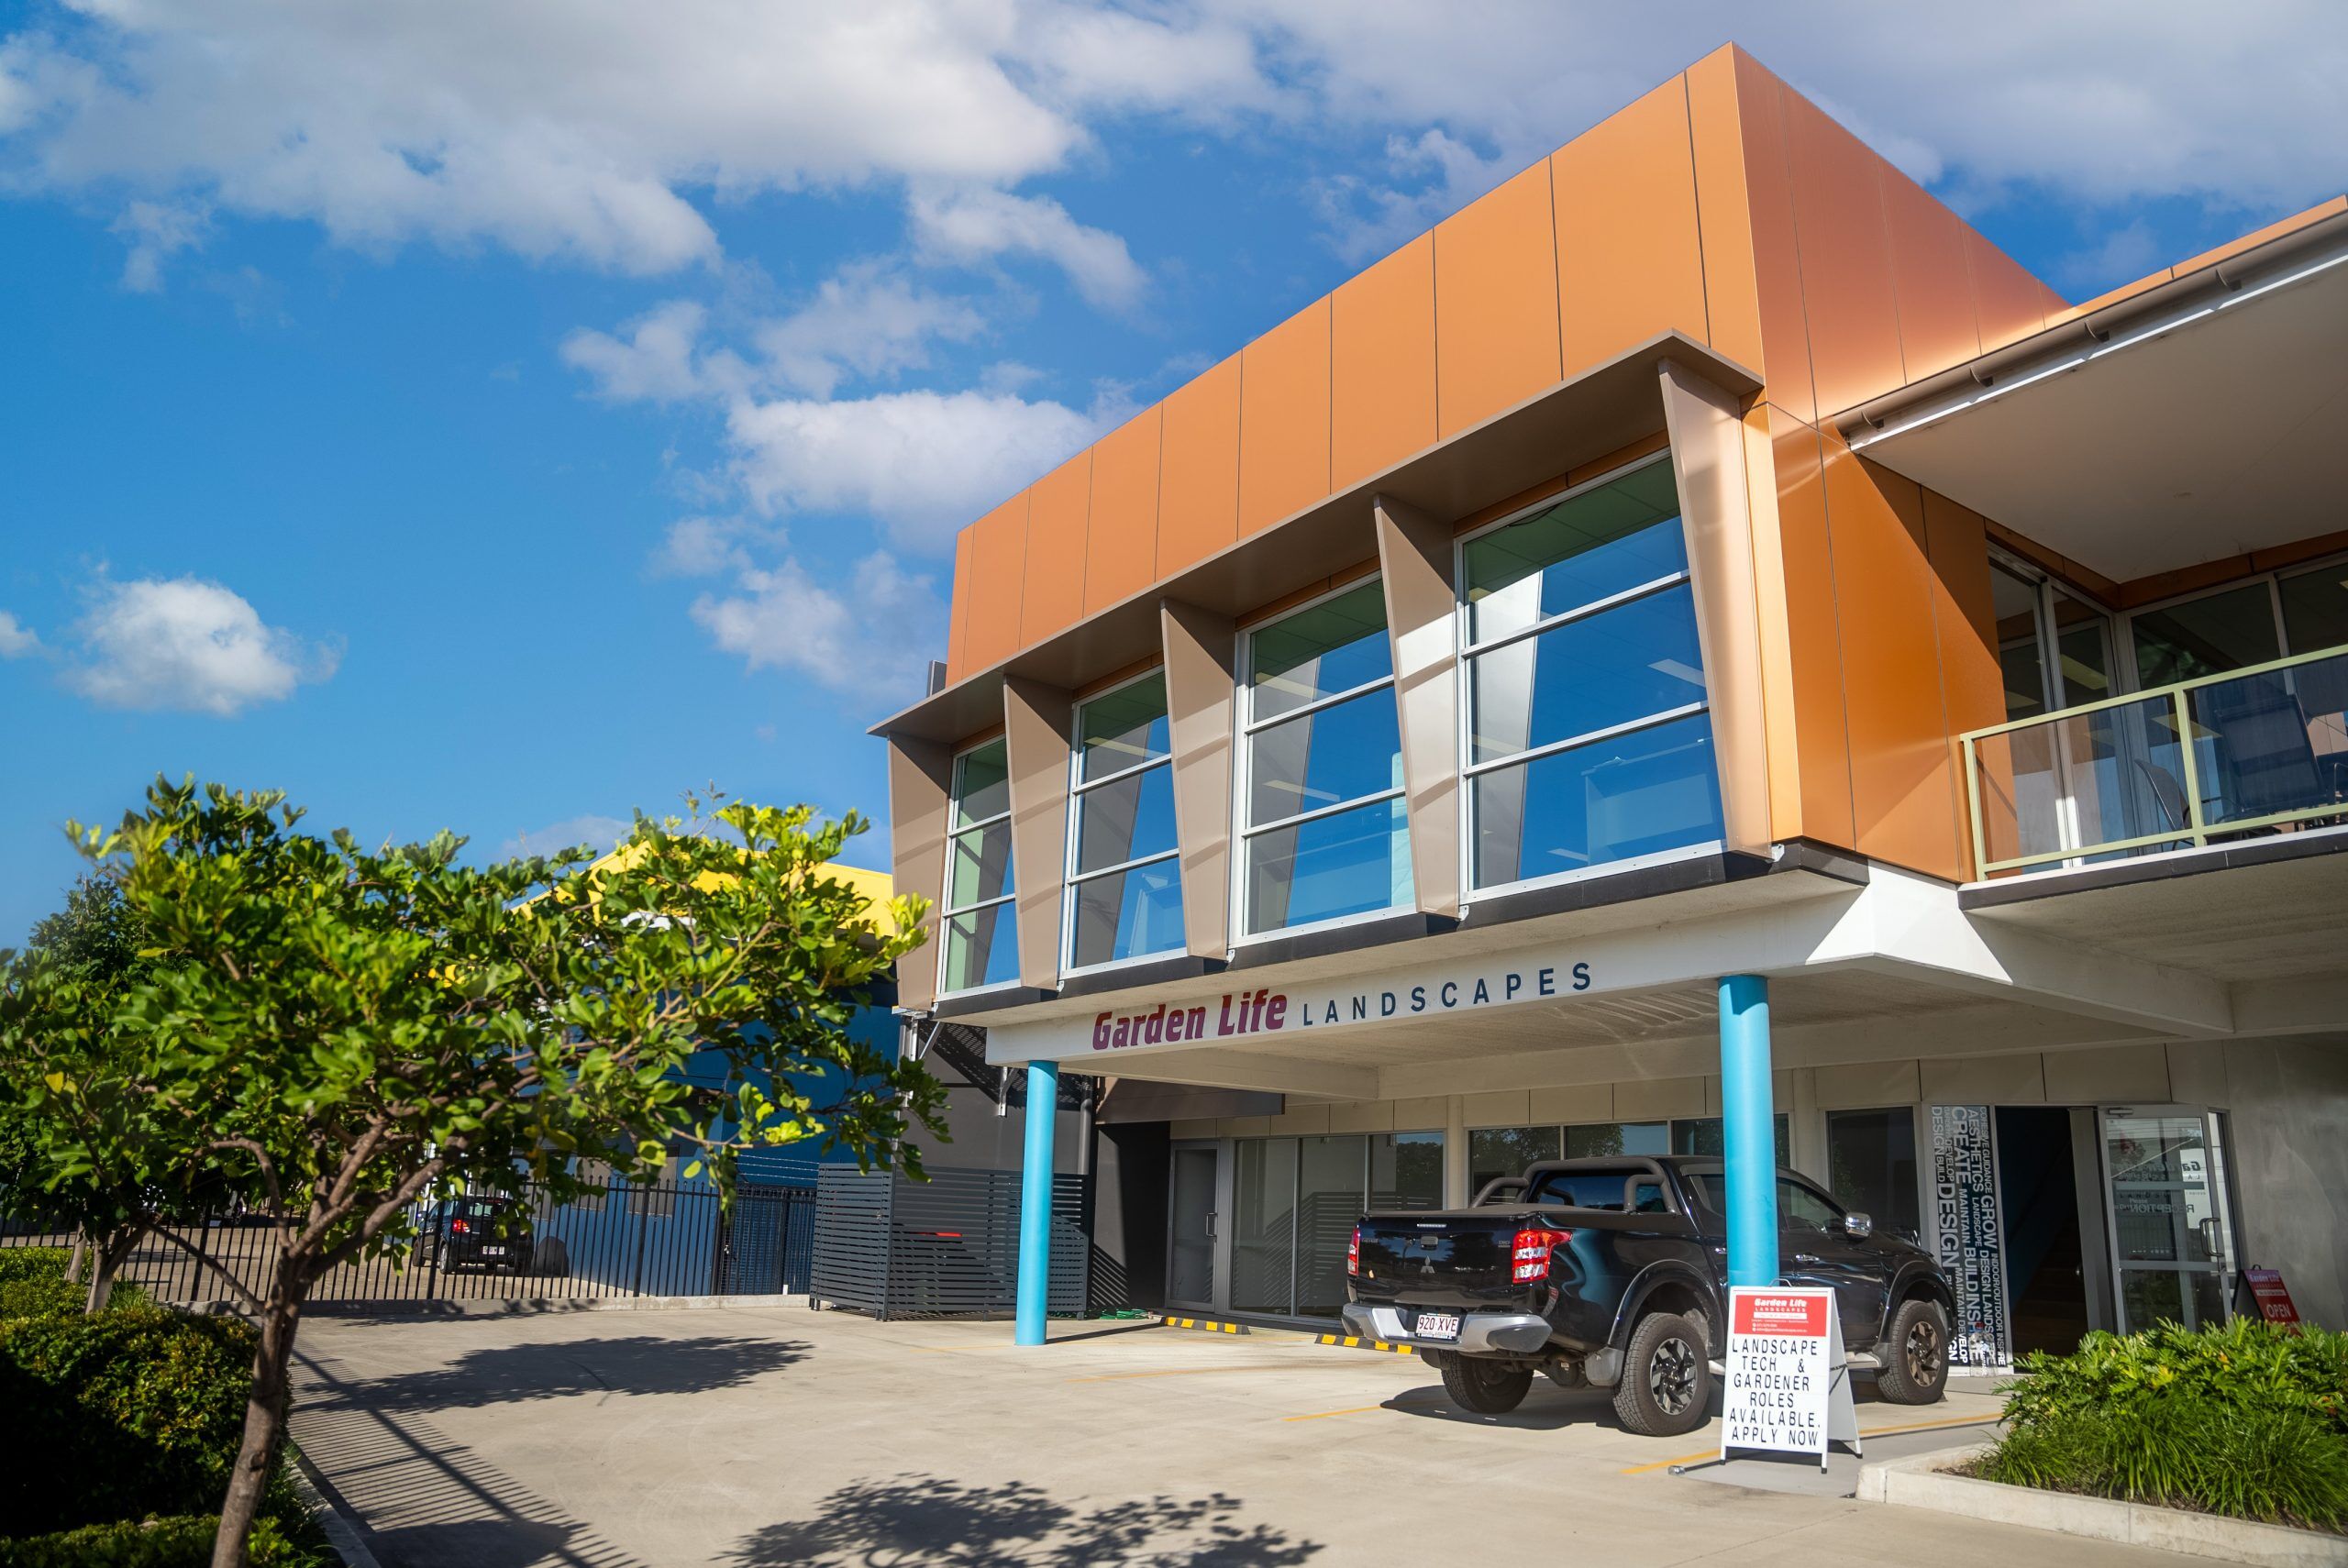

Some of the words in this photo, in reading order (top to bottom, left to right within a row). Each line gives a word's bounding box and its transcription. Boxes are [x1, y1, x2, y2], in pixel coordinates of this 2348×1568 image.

[1092, 1005, 1206, 1051] Garden
[1217, 988, 1287, 1037] Life
[1302, 962, 1591, 1027] LANDSCAPES
[1933, 1107, 1944, 1155] DESIGN
[1953, 1107, 1972, 1184] CREATE
[1981, 1107, 1990, 1148] COHESIVE
[1937, 1156, 1945, 1182] BUILD
[1945, 1139, 1955, 1182] DEVELOP
[1969, 1110, 1984, 1192] AESTHETICS
[1983, 1149, 1993, 1193] GUIDANCE
[1938, 1183, 1960, 1267] DESIGN
[1959, 1188, 1970, 1243] MAINTAIN
[1973, 1197, 1982, 1248] LANDSCAPE
[1981, 1195, 1998, 1248] GROW
[1965, 1247, 1979, 1291] BUILD
[1980, 1251, 1991, 1291] DESIGN
[1755, 1298, 1787, 1307] Garden
[1789, 1299, 1807, 1308] Life
[1956, 1267, 1966, 1317] MAINTAIN
[1992, 1253, 2004, 1331] INDOOR/OUTDOOR
[2266, 1304, 2291, 1318] OPEN
[1419, 1317, 1435, 1331] 920
[1438, 1318, 1457, 1331] XVE
[1959, 1320, 1968, 1363] DEVELOP
[1732, 1338, 1818, 1355] LANDSCAPE
[1742, 1356, 1777, 1371] TECH
[1798, 1359, 1805, 1373] &
[1997, 1332, 2006, 1365] INSPIRE
[1733, 1374, 1810, 1391] GARDENER
[1750, 1392, 1794, 1408] ROLES
[1730, 1408, 1820, 1428] AVAILABLE.
[1732, 1427, 1778, 1443] APPLY
[1789, 1430, 1818, 1446] NOW
